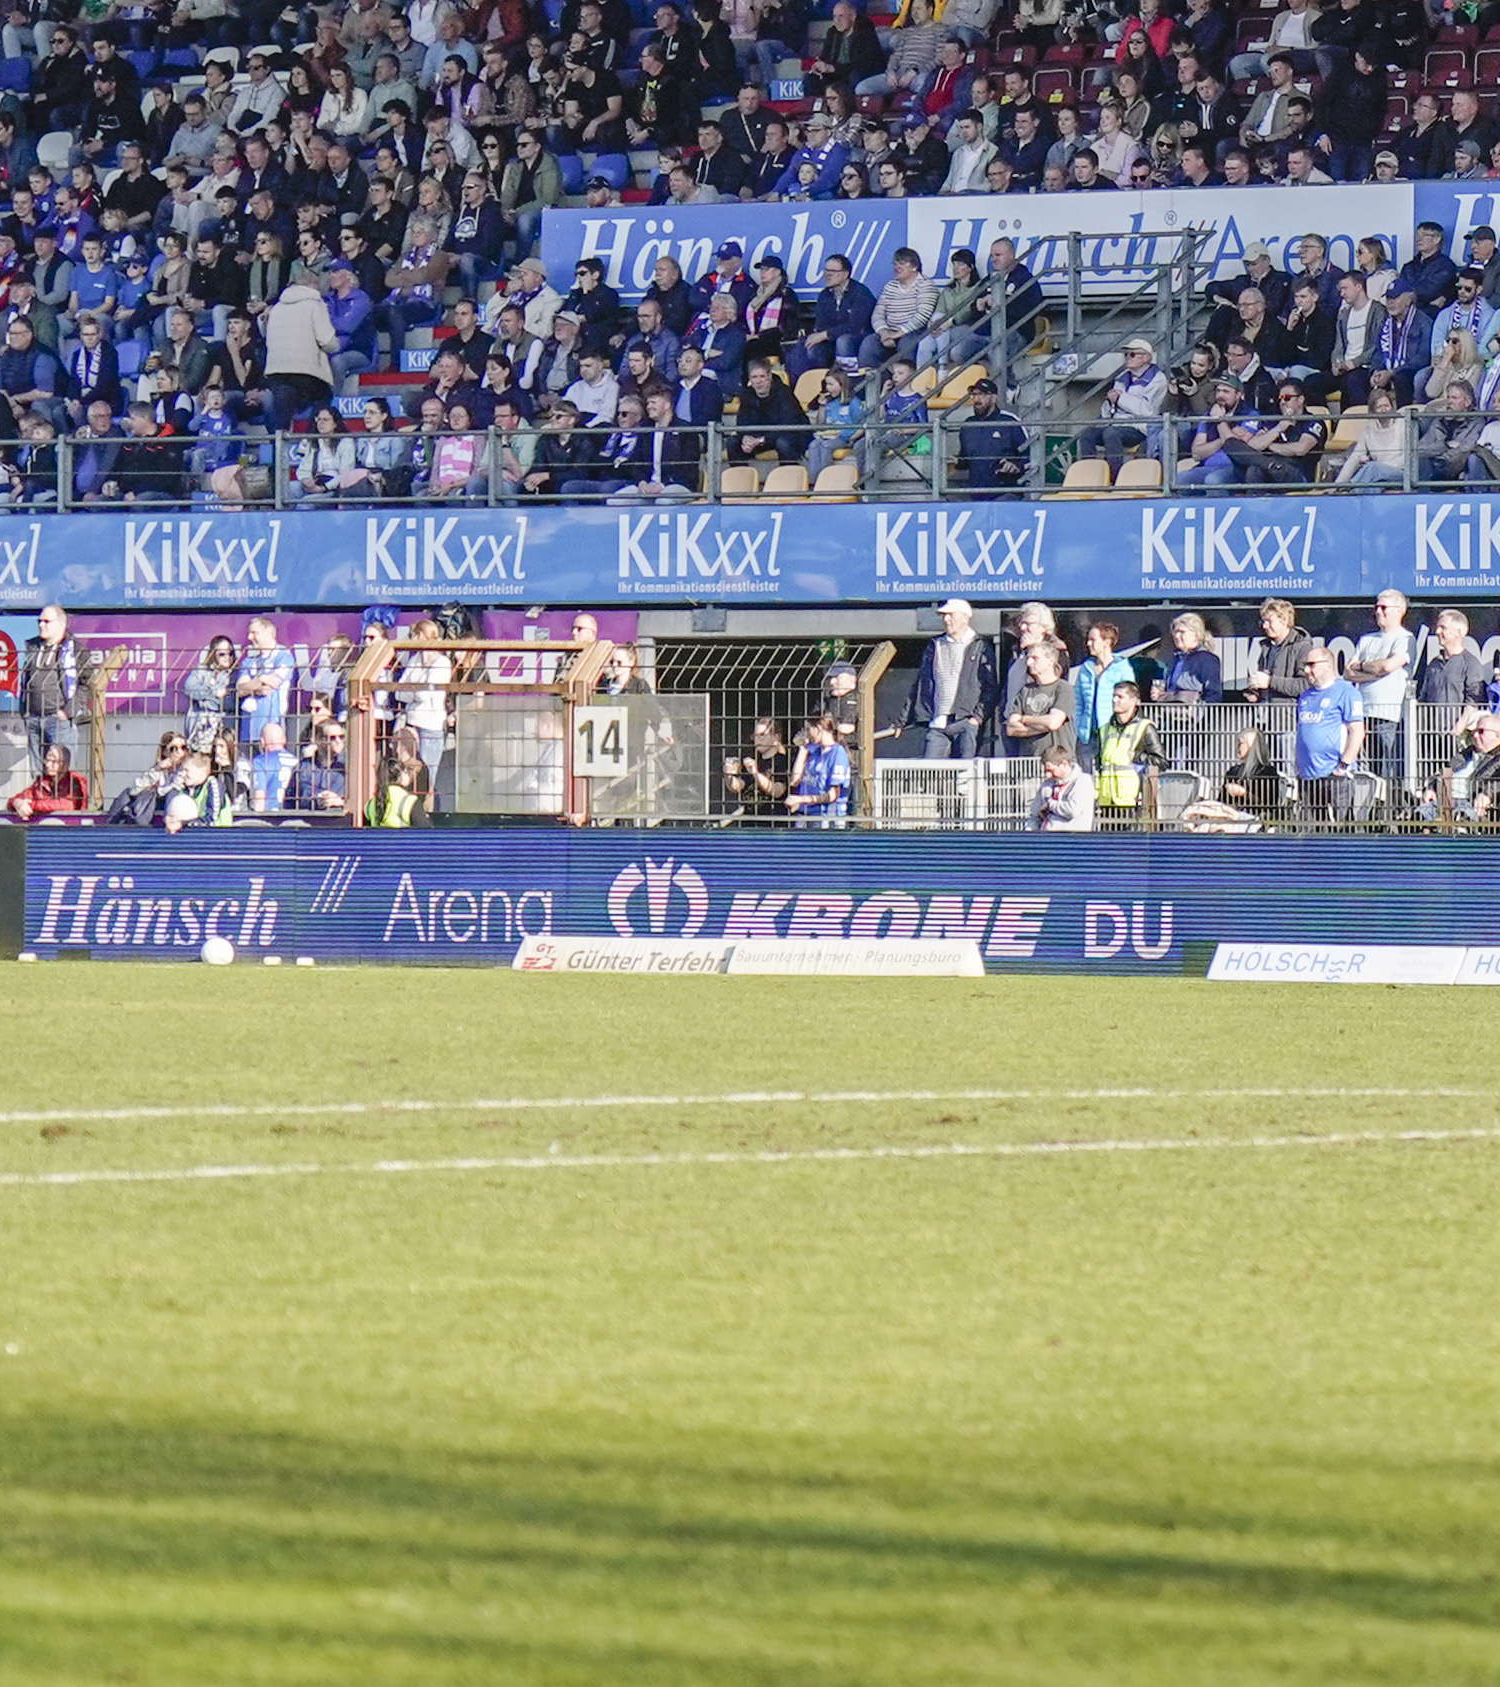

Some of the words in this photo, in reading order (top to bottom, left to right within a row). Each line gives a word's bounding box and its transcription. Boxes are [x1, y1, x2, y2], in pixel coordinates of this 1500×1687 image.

[124, 519, 281, 584] KiKxxl
[365, 515, 528, 581] KiKxxl
[618, 511, 783, 578] KiKxxl
[875, 509, 1046, 577] KiKxxl
[1141, 506, 1317, 573] KiKxxl
[579, 719, 622, 764] 14
[33, 874, 279, 946] Hänsch
[383, 872, 554, 943] Arena
[721, 891, 1051, 958] KRONE
[1084, 899, 1173, 961] DU
[567, 949, 644, 971] Günter
[650, 951, 726, 973] Terfehr
